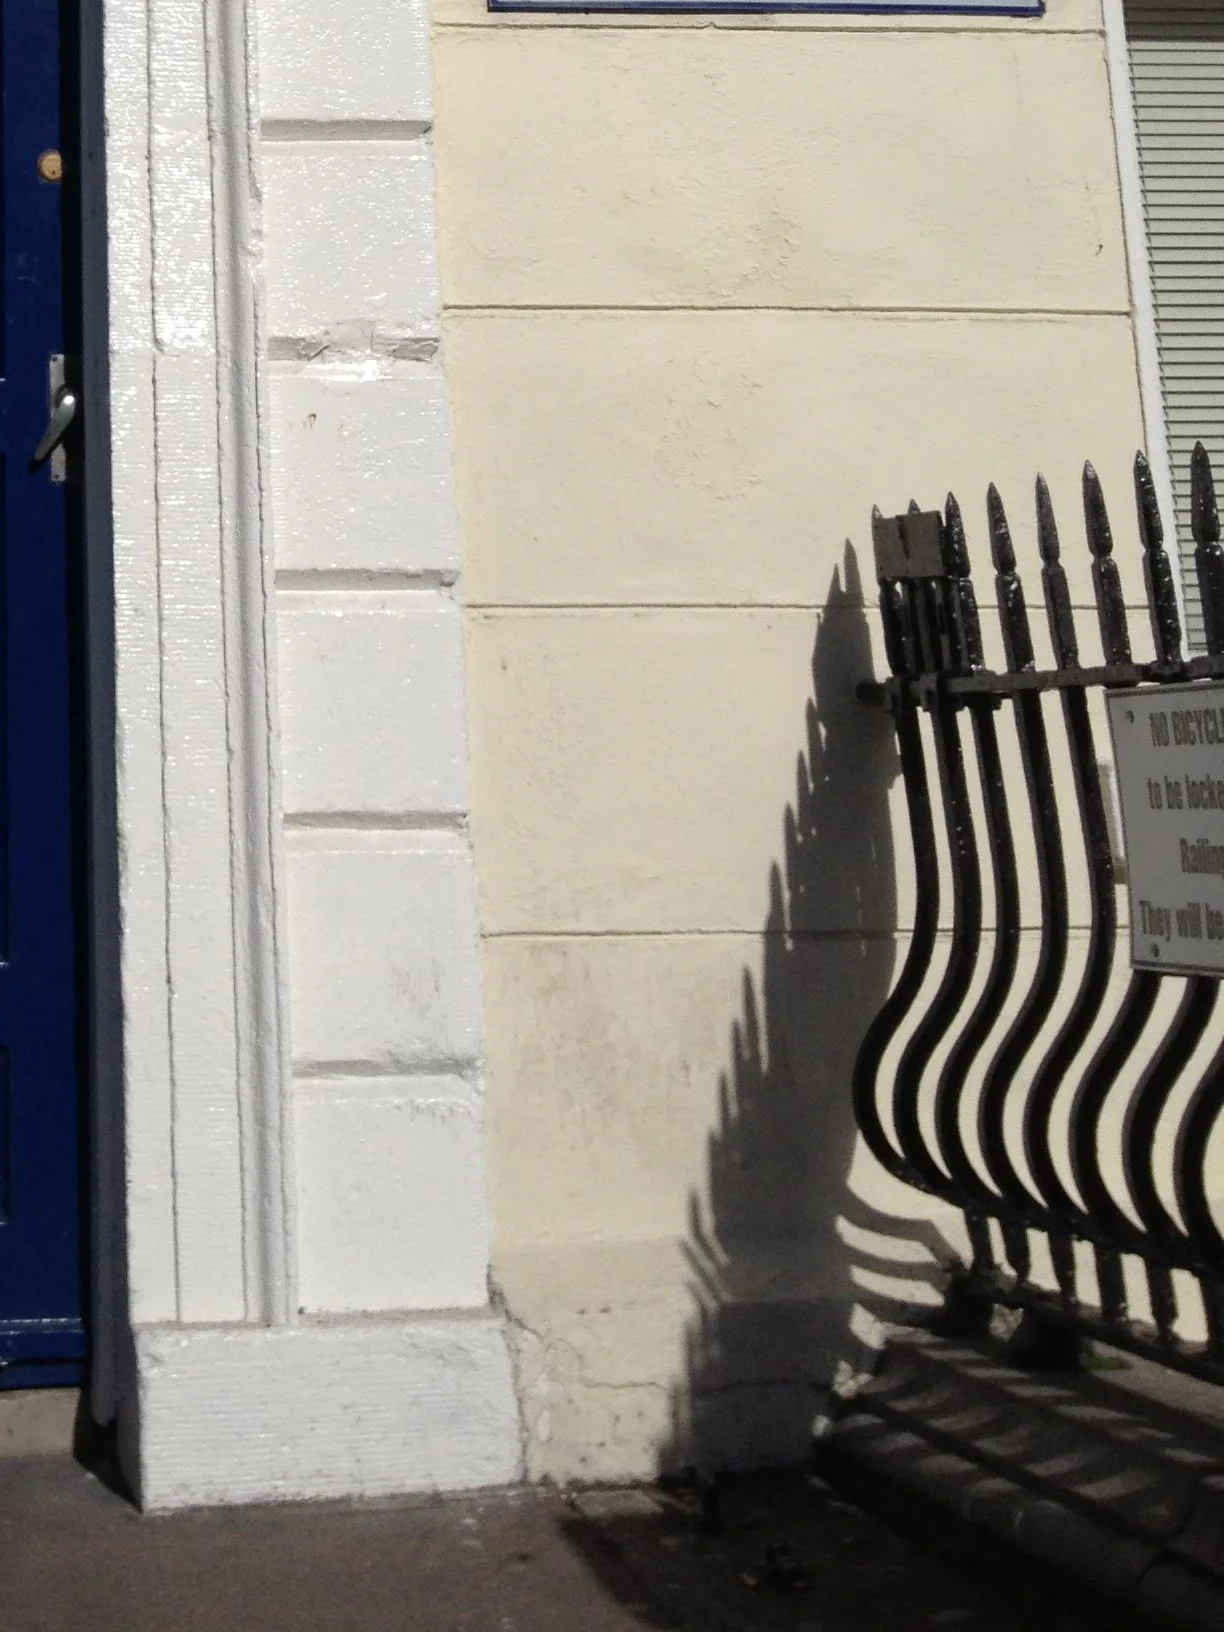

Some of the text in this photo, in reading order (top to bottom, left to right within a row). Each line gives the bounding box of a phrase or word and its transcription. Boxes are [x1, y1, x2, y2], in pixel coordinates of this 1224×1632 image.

[1147, 776, 1163, 809] to
[1164, 775, 1183, 810] be
[1138, 900, 1172, 942] They
[1176, 902, 1202, 939] will
